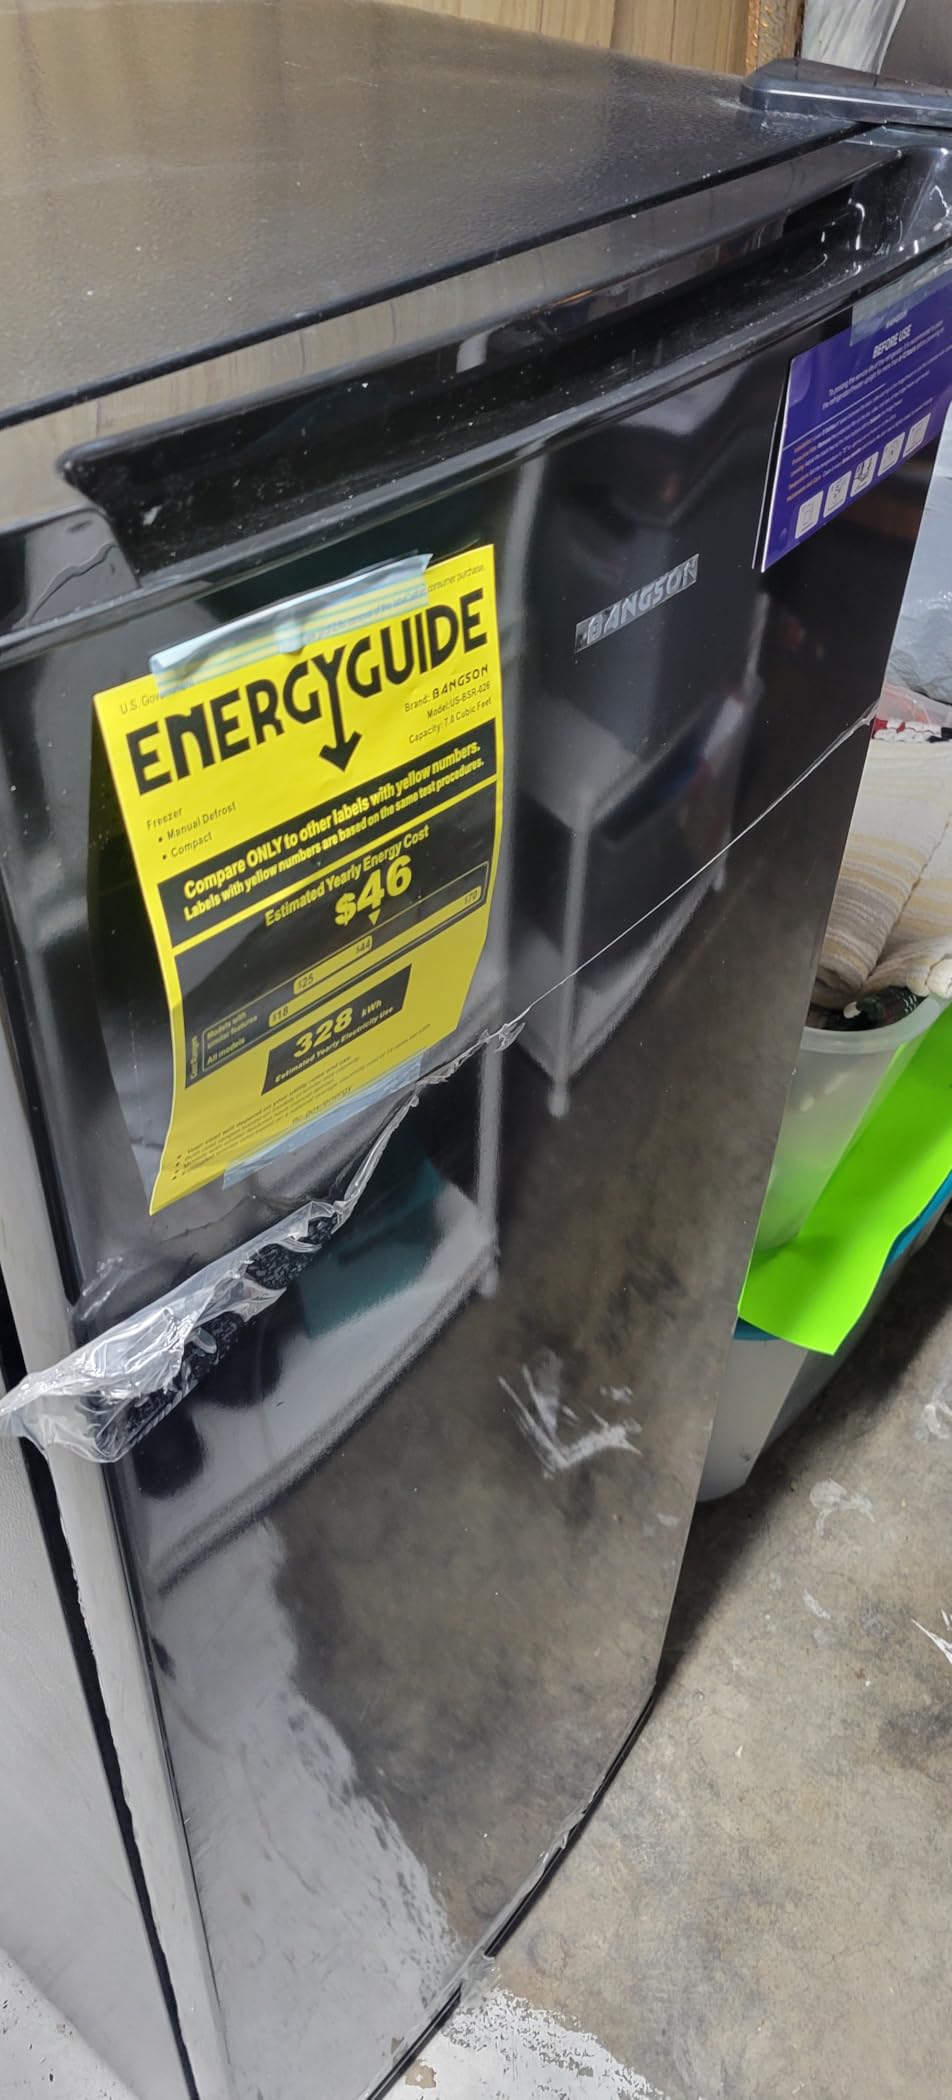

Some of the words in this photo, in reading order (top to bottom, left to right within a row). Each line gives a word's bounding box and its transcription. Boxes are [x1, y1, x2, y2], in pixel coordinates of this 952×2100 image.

[872, 332, 899, 359] BEFORE
[899, 324, 912, 342] USE
[588, 558, 698, 645] BANGSON
[126, 588, 488, 796] ENERGYGUIDE
[404, 695, 430, 713] Brand:
[433, 664, 488, 699] BANGSON
[409, 722, 444, 743] Capacity:
[456, 706, 476, 720] Cubic
[477, 697, 492, 711] Feet
[146, 808, 182, 831] Freezer
[167, 818, 201, 840] Manual
[202, 801, 236, 825] Defrost
[171, 832, 213, 857] Compact
[183, 859, 246, 899] Compare
[246, 836, 283, 868] ONLY
[284, 834, 299, 849] to
[300, 814, 332, 842] other
[332, 797, 369, 825] labels
[370, 781, 395, 806] with
[395, 765, 431, 797] yellow
[432, 742, 481, 774] numbers.
[183, 892, 221, 921] Labels
[221, 881, 245, 901] with
[245, 863, 278, 893] yellow
[278, 840, 322, 873] numbers
[322, 833, 338, 850] are
[338, 819, 367, 842] based
[368, 813, 379, 826] on
[380, 806, 395, 820] the
[395, 792, 418, 812] same
[419, 782, 436, 799] test
[436, 757, 485, 793] procedures.
[264, 881, 325, 927] Estimated
[325, 862, 361, 892] Yearly
[363, 841, 402, 872] Energy
[403, 824, 430, 848] Cost
[334, 855, 412, 926] $46
[275, 1054, 315, 1083] Estimated
[316, 1041, 340, 1058] Yearly
[340, 1015, 379, 1043] Electricity
[380, 1007, 394, 1019] Use
[293, 1008, 353, 1058] 328
[361, 999, 382, 1018] kWh
[207, 1053, 218, 1066] All
